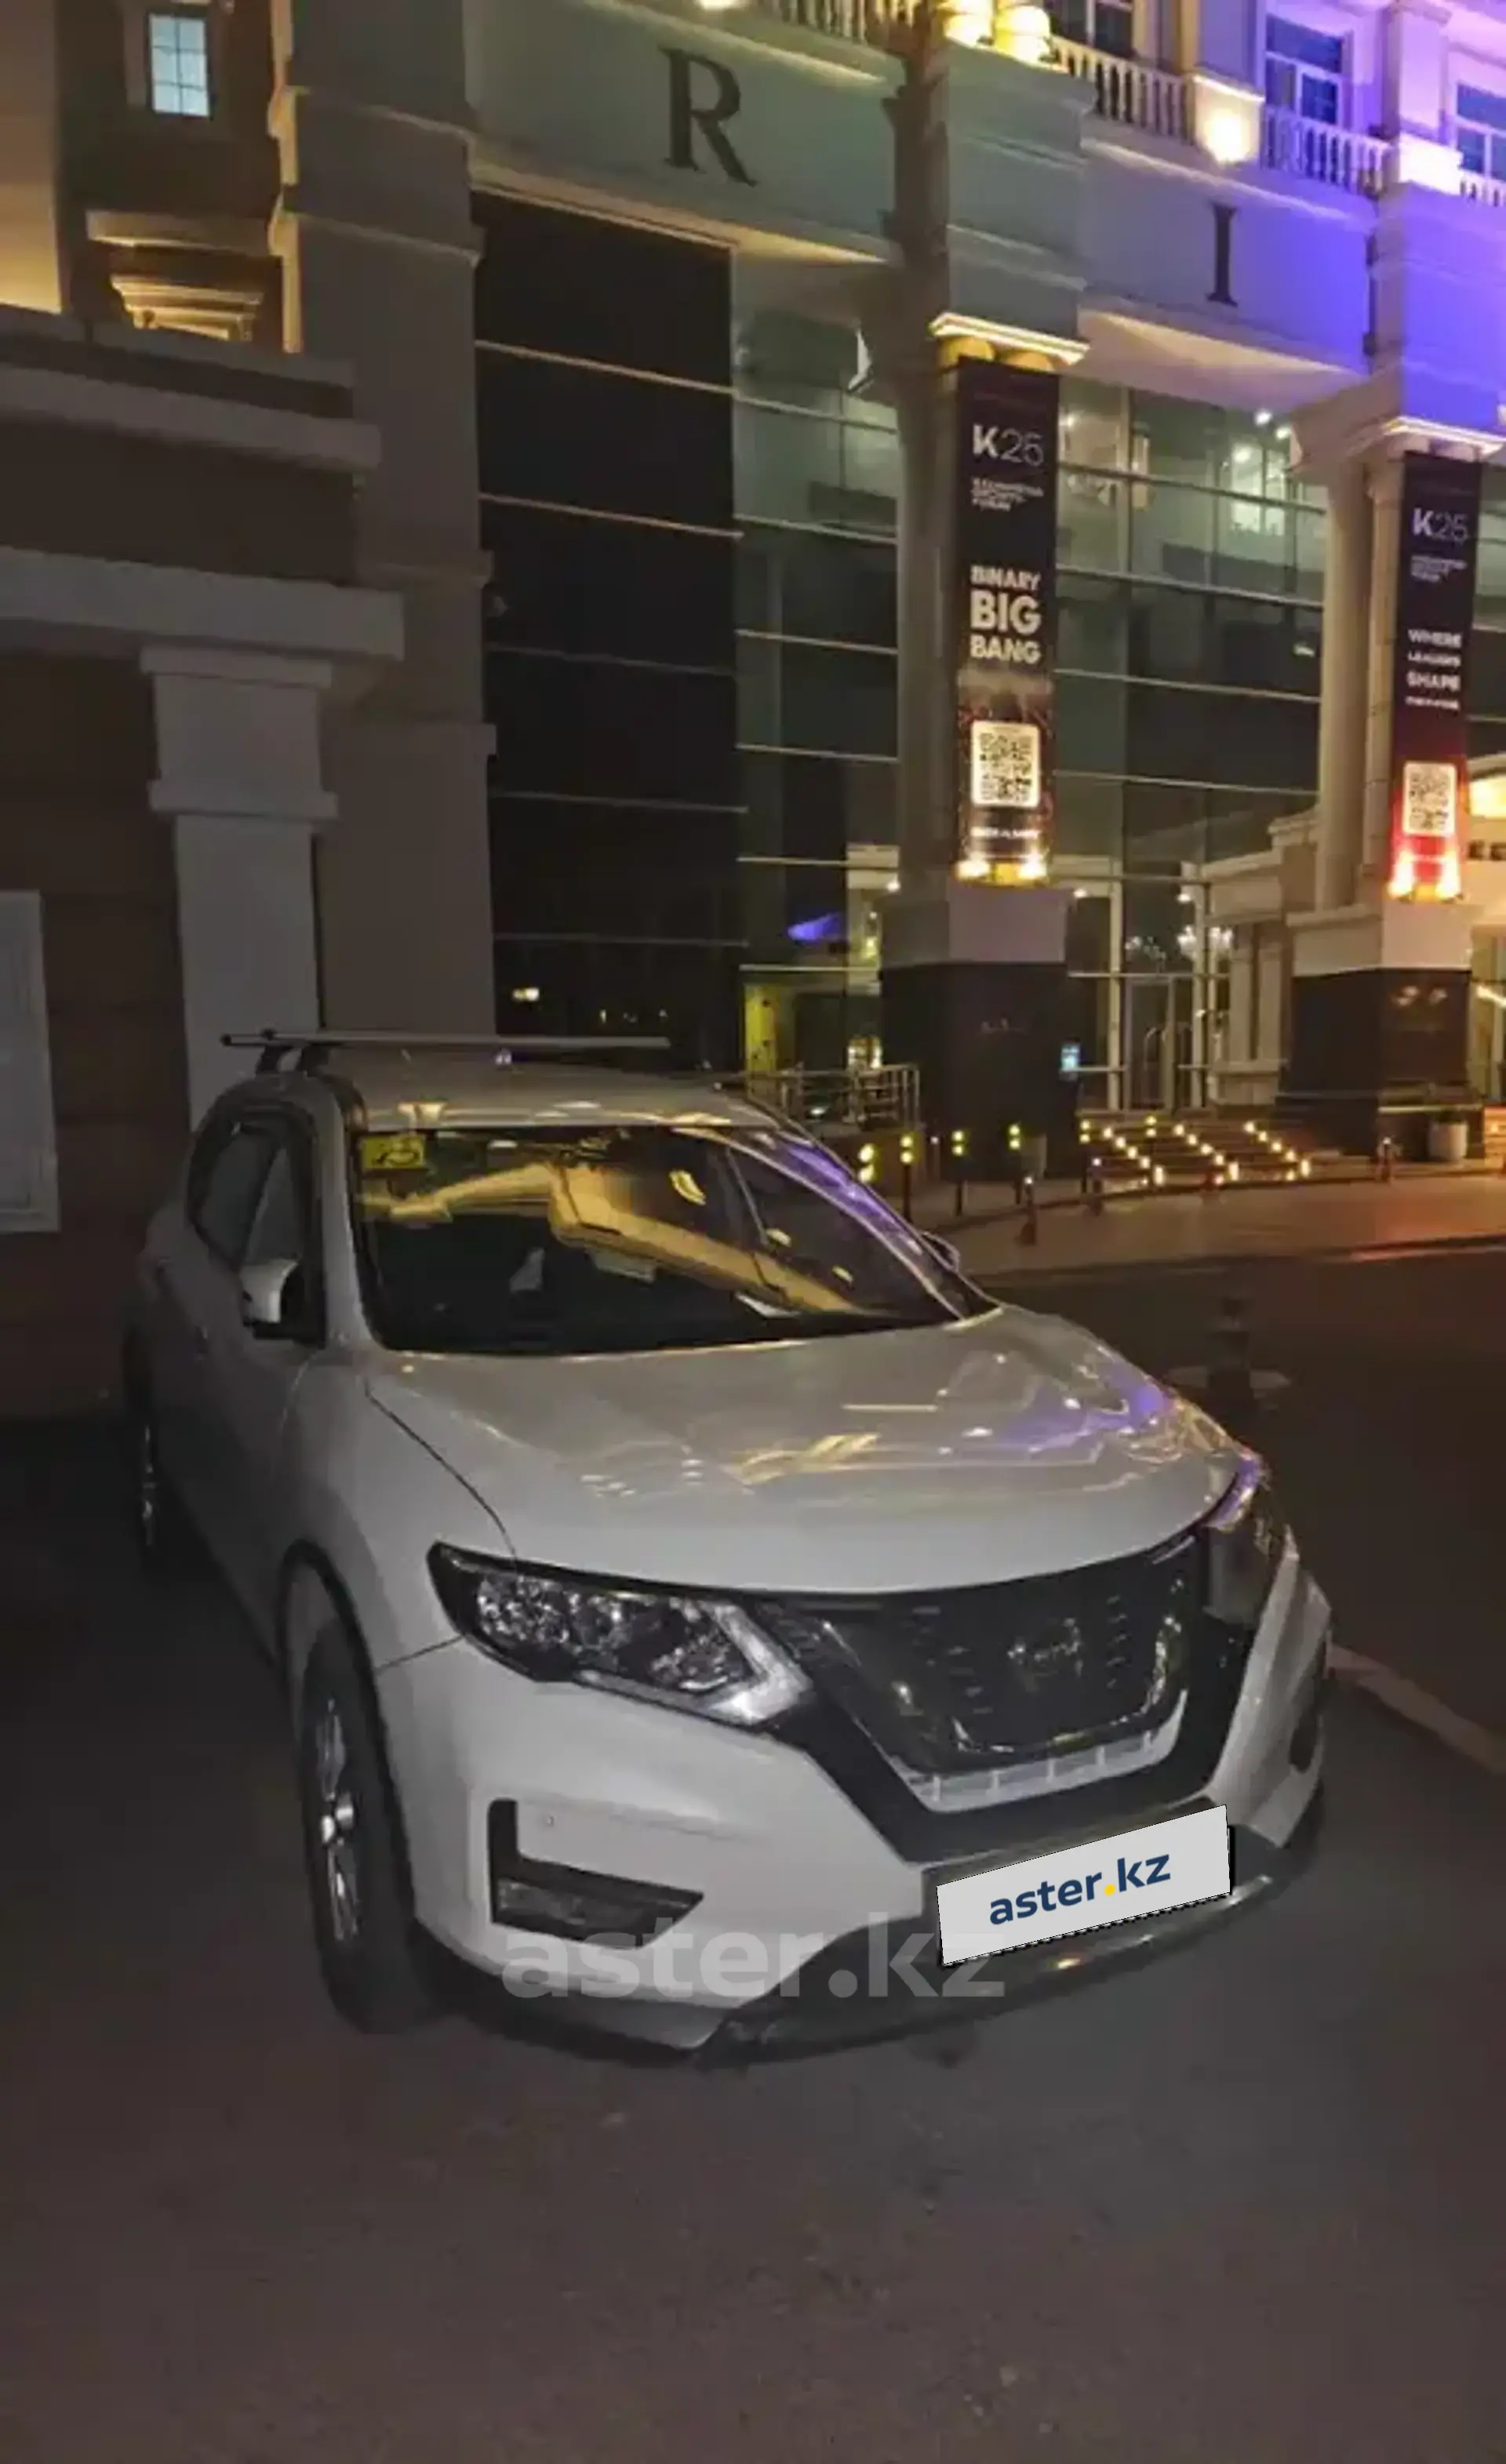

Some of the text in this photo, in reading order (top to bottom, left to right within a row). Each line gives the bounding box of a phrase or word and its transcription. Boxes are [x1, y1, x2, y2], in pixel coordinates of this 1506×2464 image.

[659, 45, 761, 188] R
[1205, 201, 1239, 308] I
[973, 423, 1043, 467] K25
[1413, 508, 1468, 543] K25
[971, 565, 1042, 590] BINARY
[971, 590, 1041, 636] BIG
[970, 634, 1040, 664] BANG
